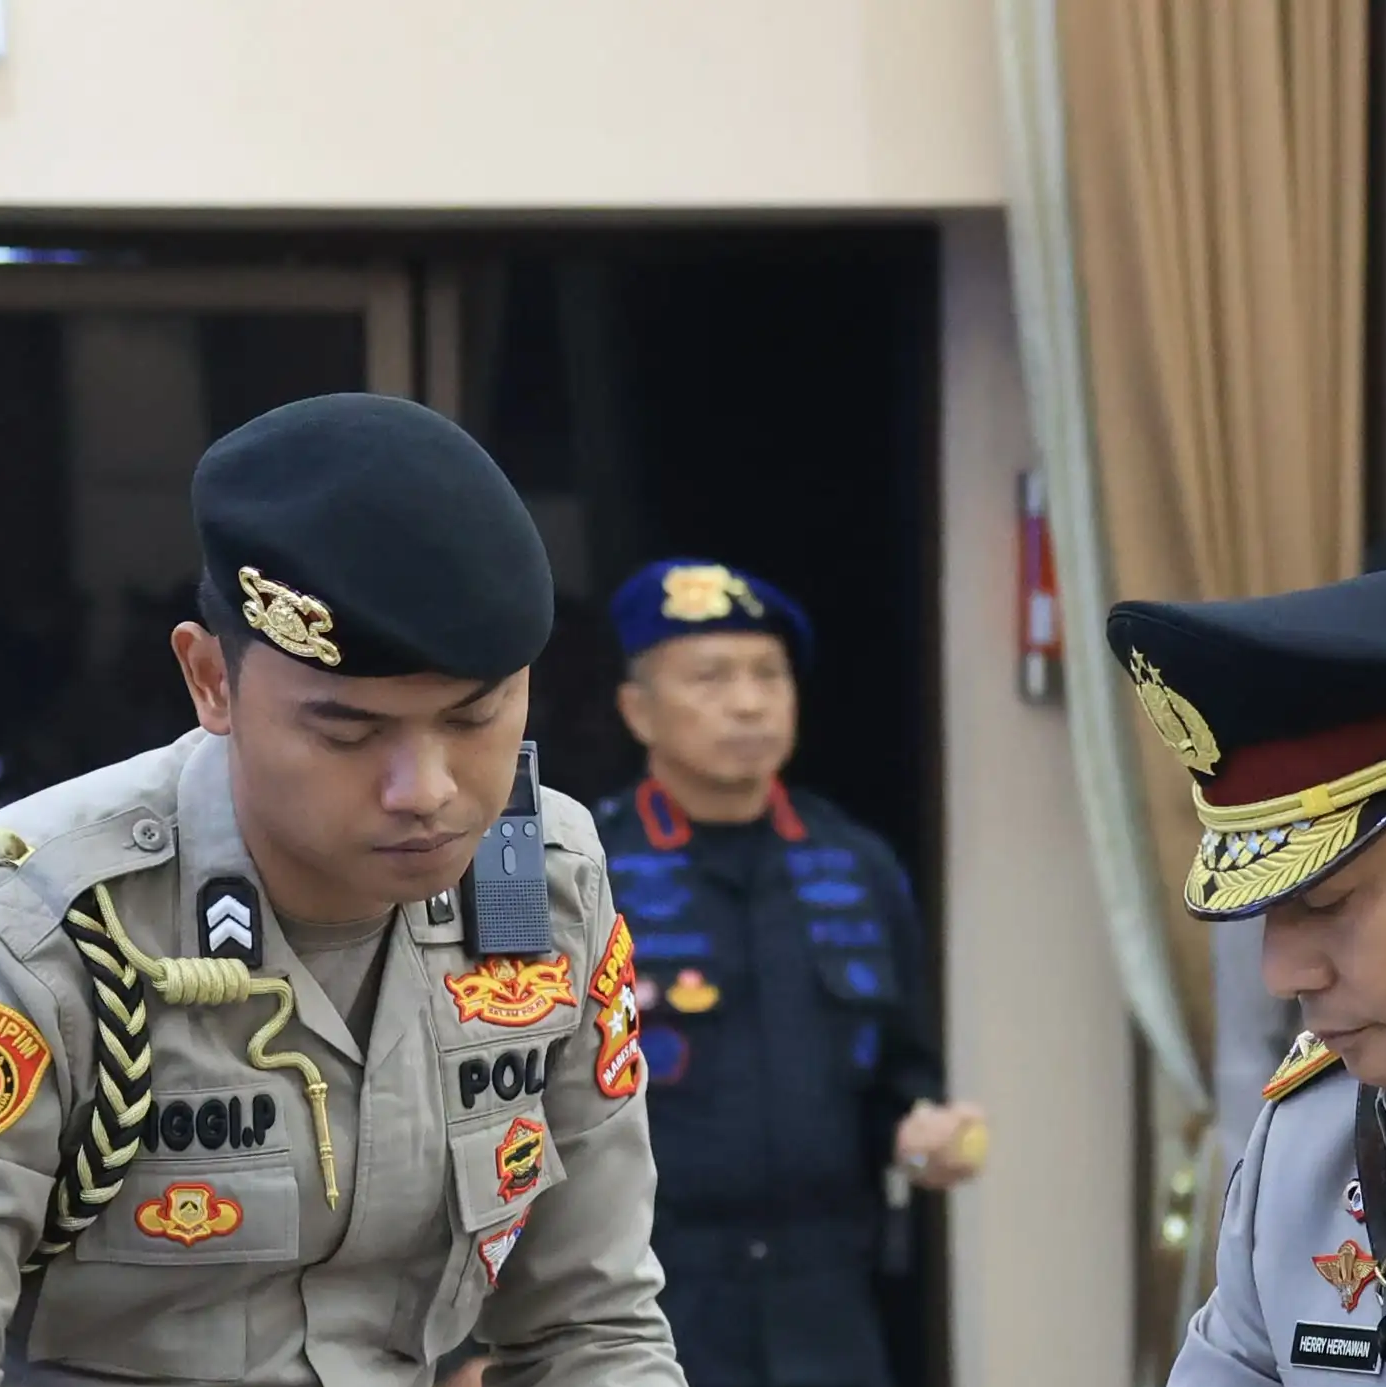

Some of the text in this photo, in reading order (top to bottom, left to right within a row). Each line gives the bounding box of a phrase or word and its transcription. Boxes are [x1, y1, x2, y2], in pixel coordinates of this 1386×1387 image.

[459, 1048, 553, 1110] POL
[1299, 1336, 1371, 1358] HERRY HERYAWAN
